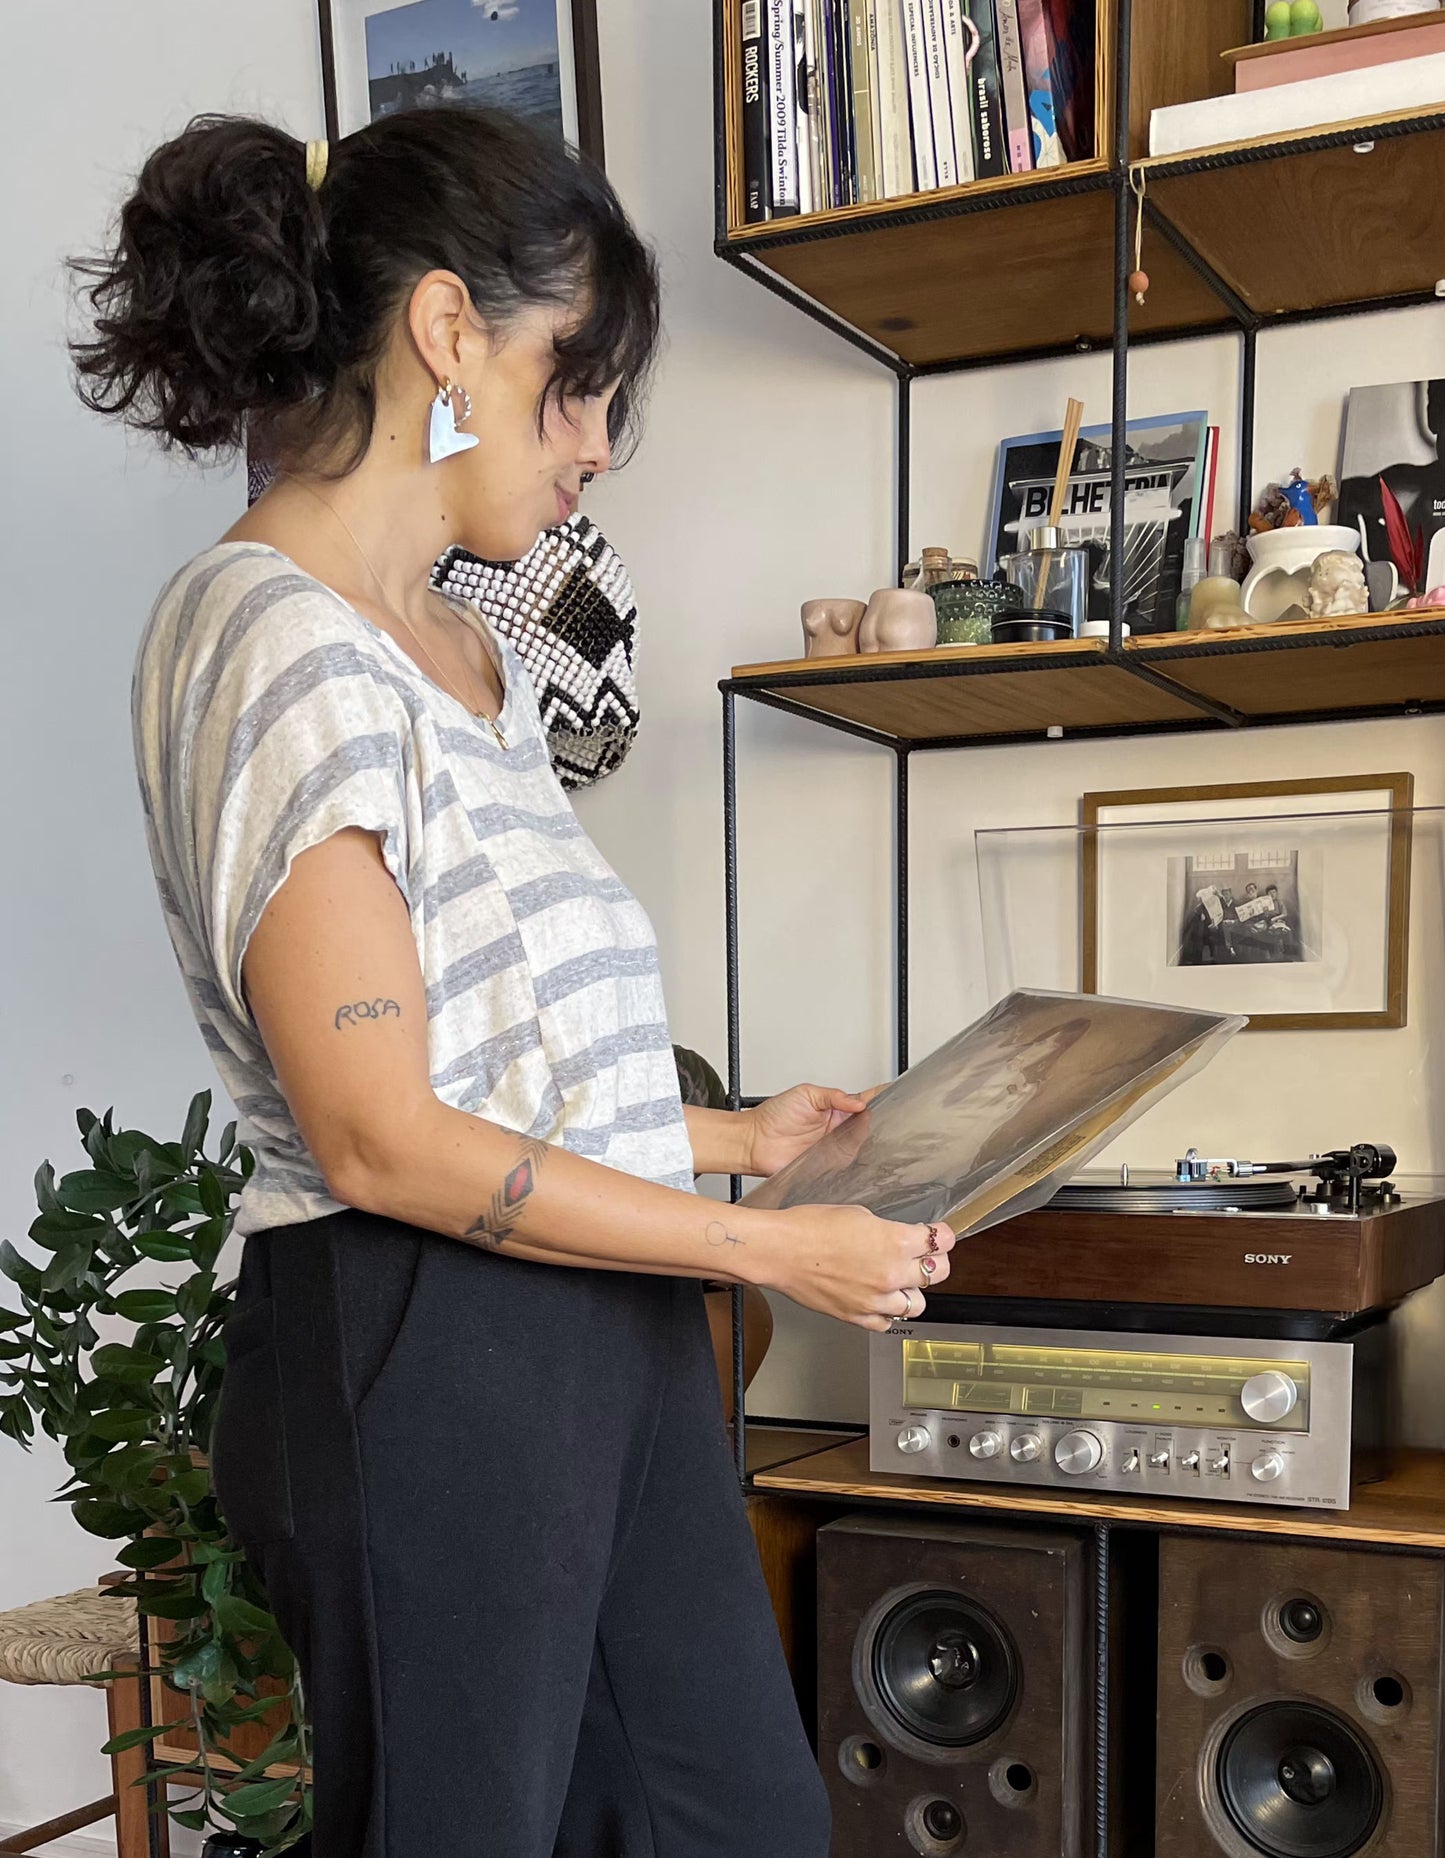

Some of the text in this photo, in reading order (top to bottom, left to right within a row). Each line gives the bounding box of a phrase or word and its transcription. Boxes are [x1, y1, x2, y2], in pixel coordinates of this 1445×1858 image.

[908, 3, 919, 77] ESPECIAL INFLUENCERS
[744, 46, 759, 104] ROCKERS
[771, 0, 788, 206] Spring/Summer 2009 Tilda Swinton
[977, 78, 993, 160] brasil saboroso
[335, 998, 401, 1030] ROSA
[1244, 1253, 1292, 1265] SONY
